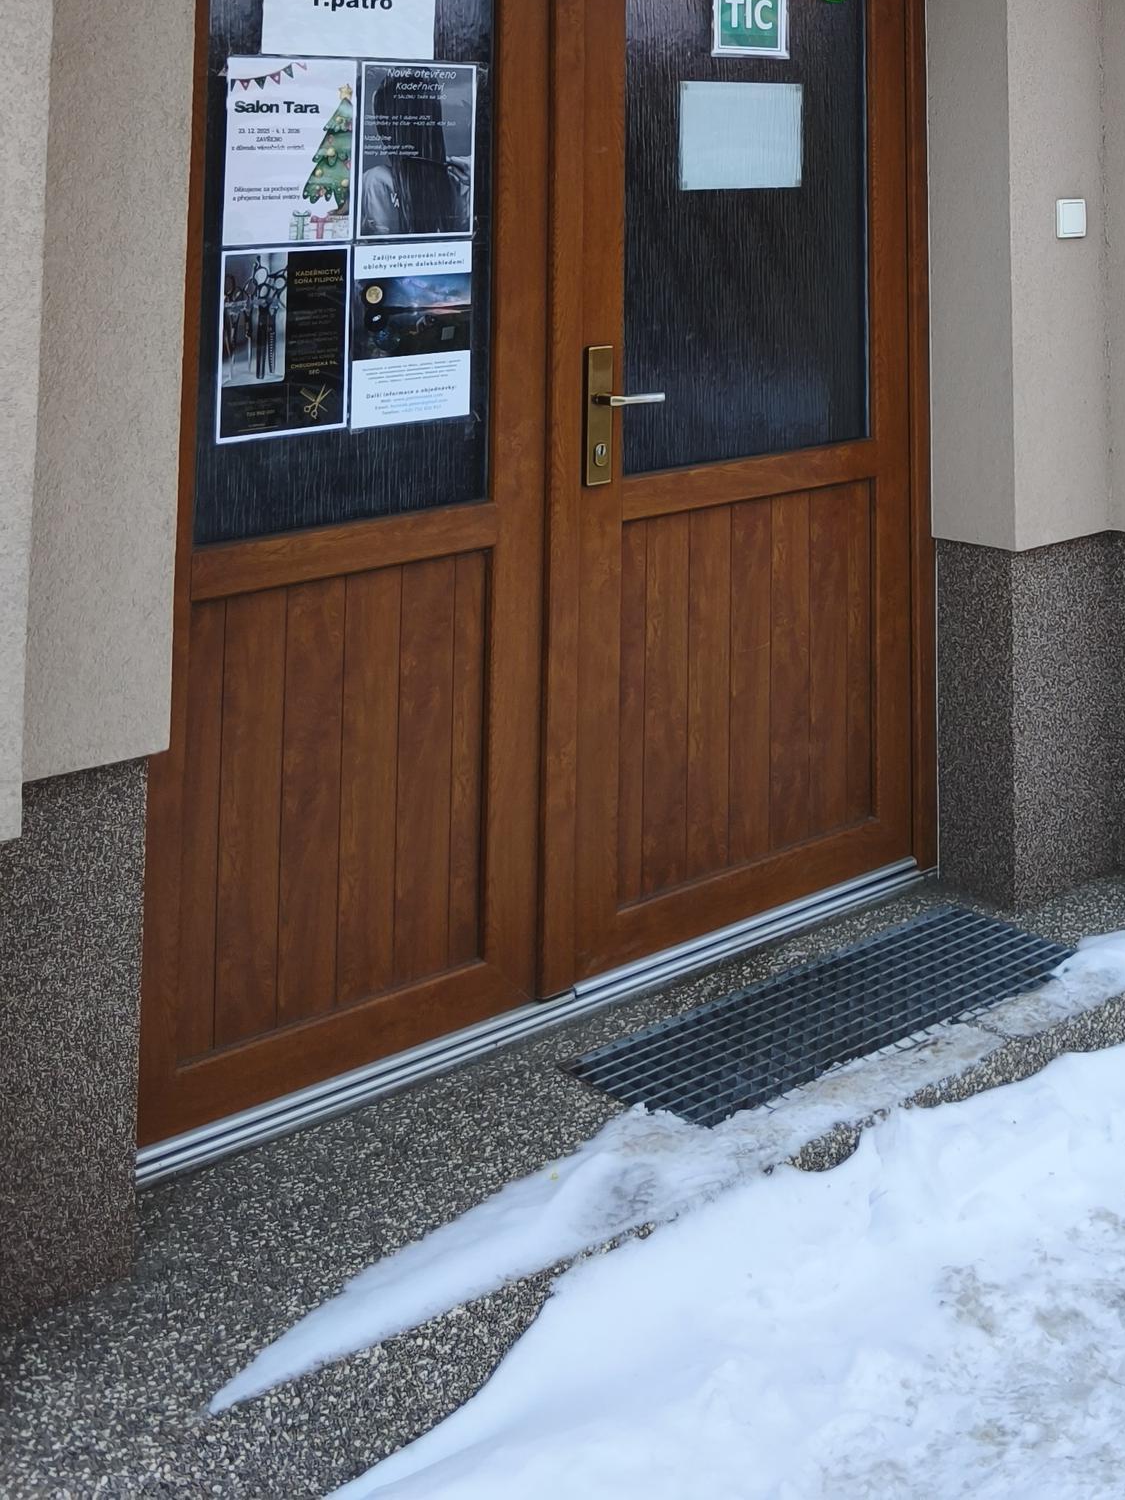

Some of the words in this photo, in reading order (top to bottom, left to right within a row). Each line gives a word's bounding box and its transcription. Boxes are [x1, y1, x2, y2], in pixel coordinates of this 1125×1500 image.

[387, 68, 412, 78] Nově
[414, 68, 457, 79] otevřeno
[395, 82, 445, 91] Kadeřnictví
[234, 99, 280, 114] Salon
[283, 101, 320, 114] Tara
[373, 253, 396, 261] Zažijte
[398, 251, 437, 260] pozorování
[389, 261, 414, 269] velkým
